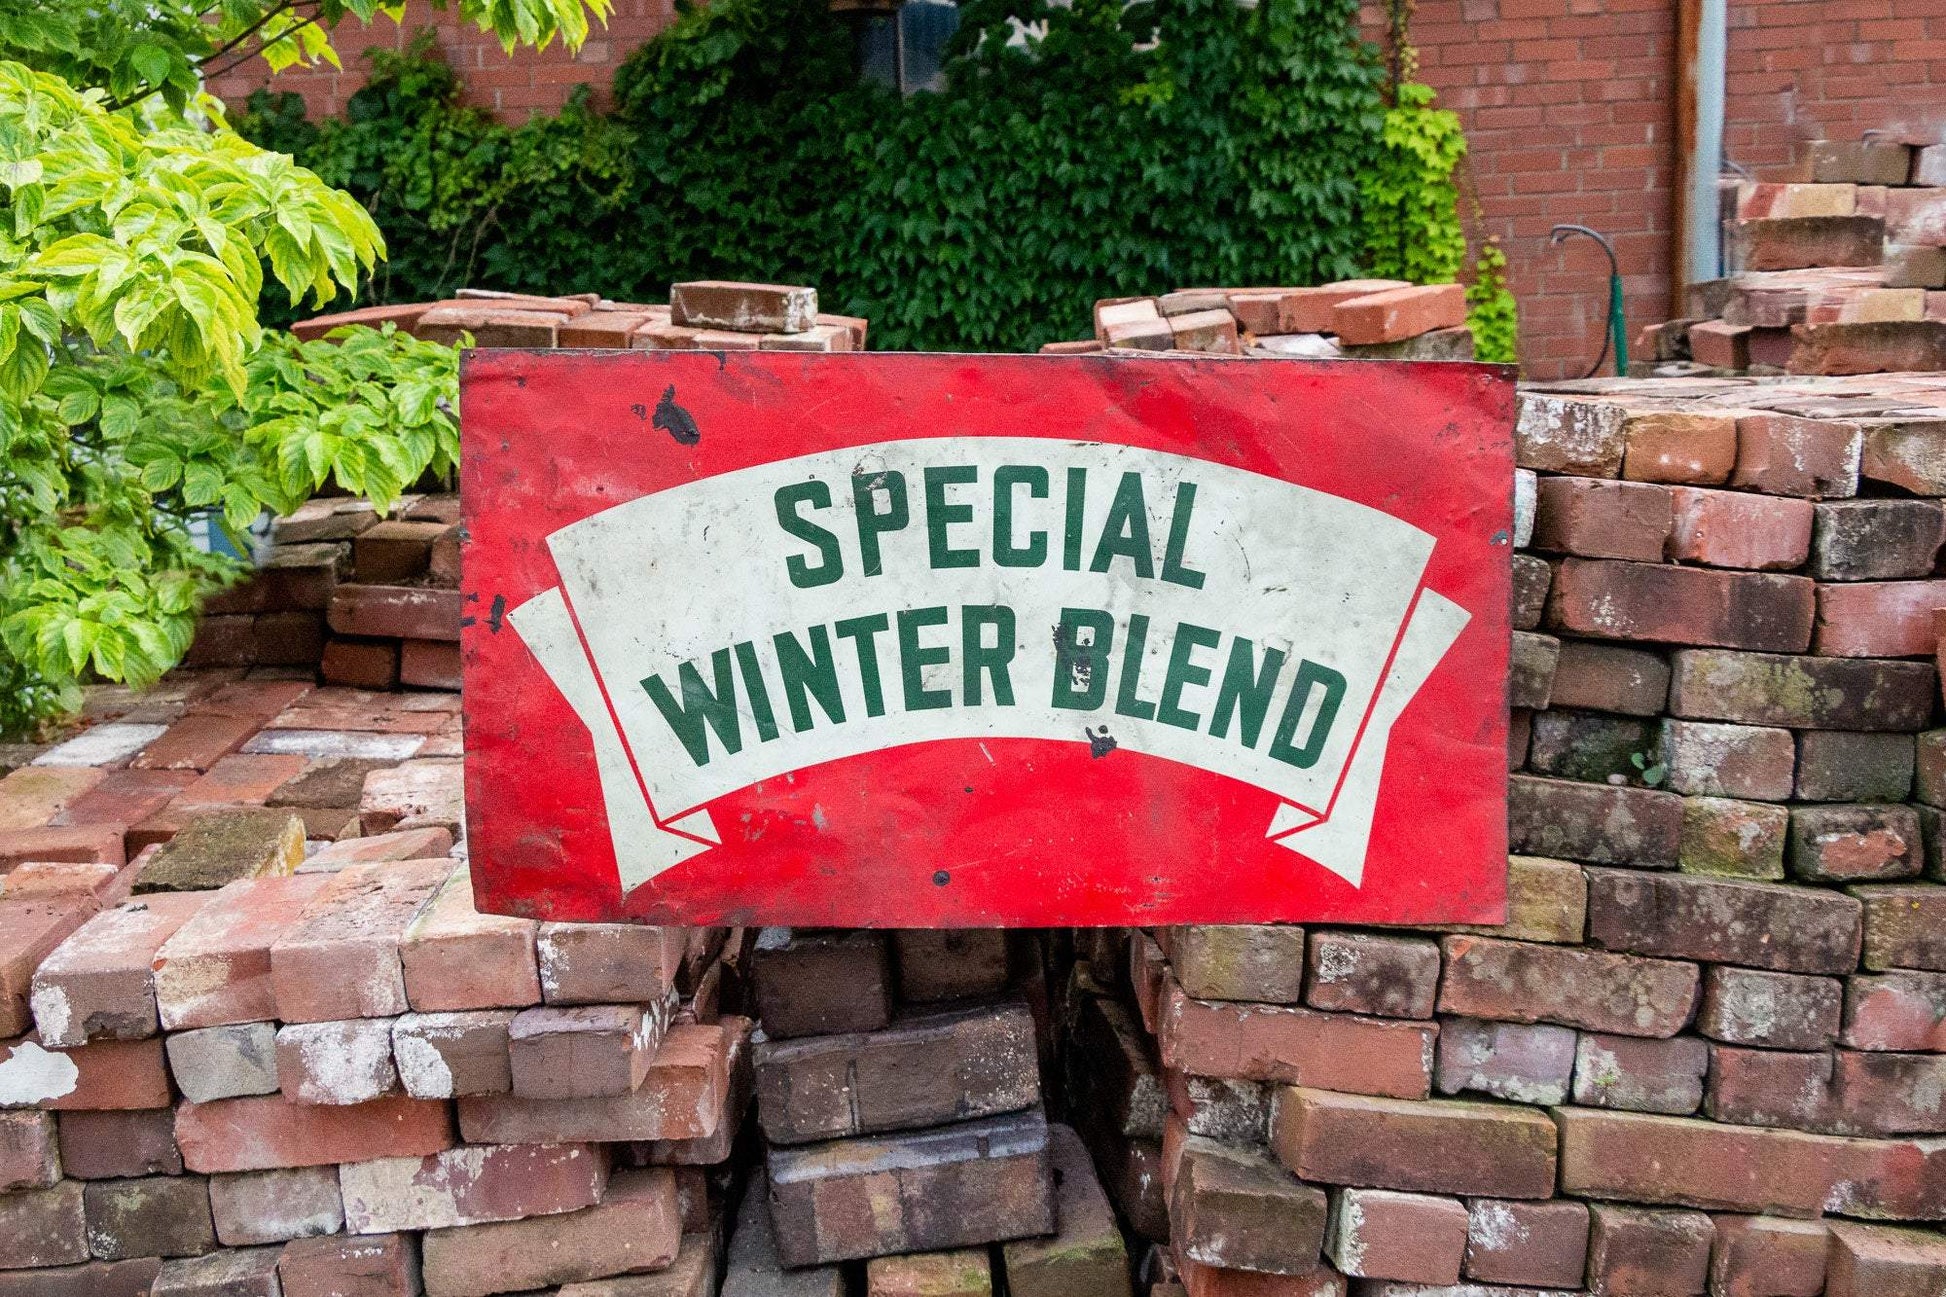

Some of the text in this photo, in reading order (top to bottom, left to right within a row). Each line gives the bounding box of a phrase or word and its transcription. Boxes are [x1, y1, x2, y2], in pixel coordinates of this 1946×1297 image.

[773, 465, 1206, 589] SPECIAL
[639, 604, 1348, 769] WINTER BLEND
